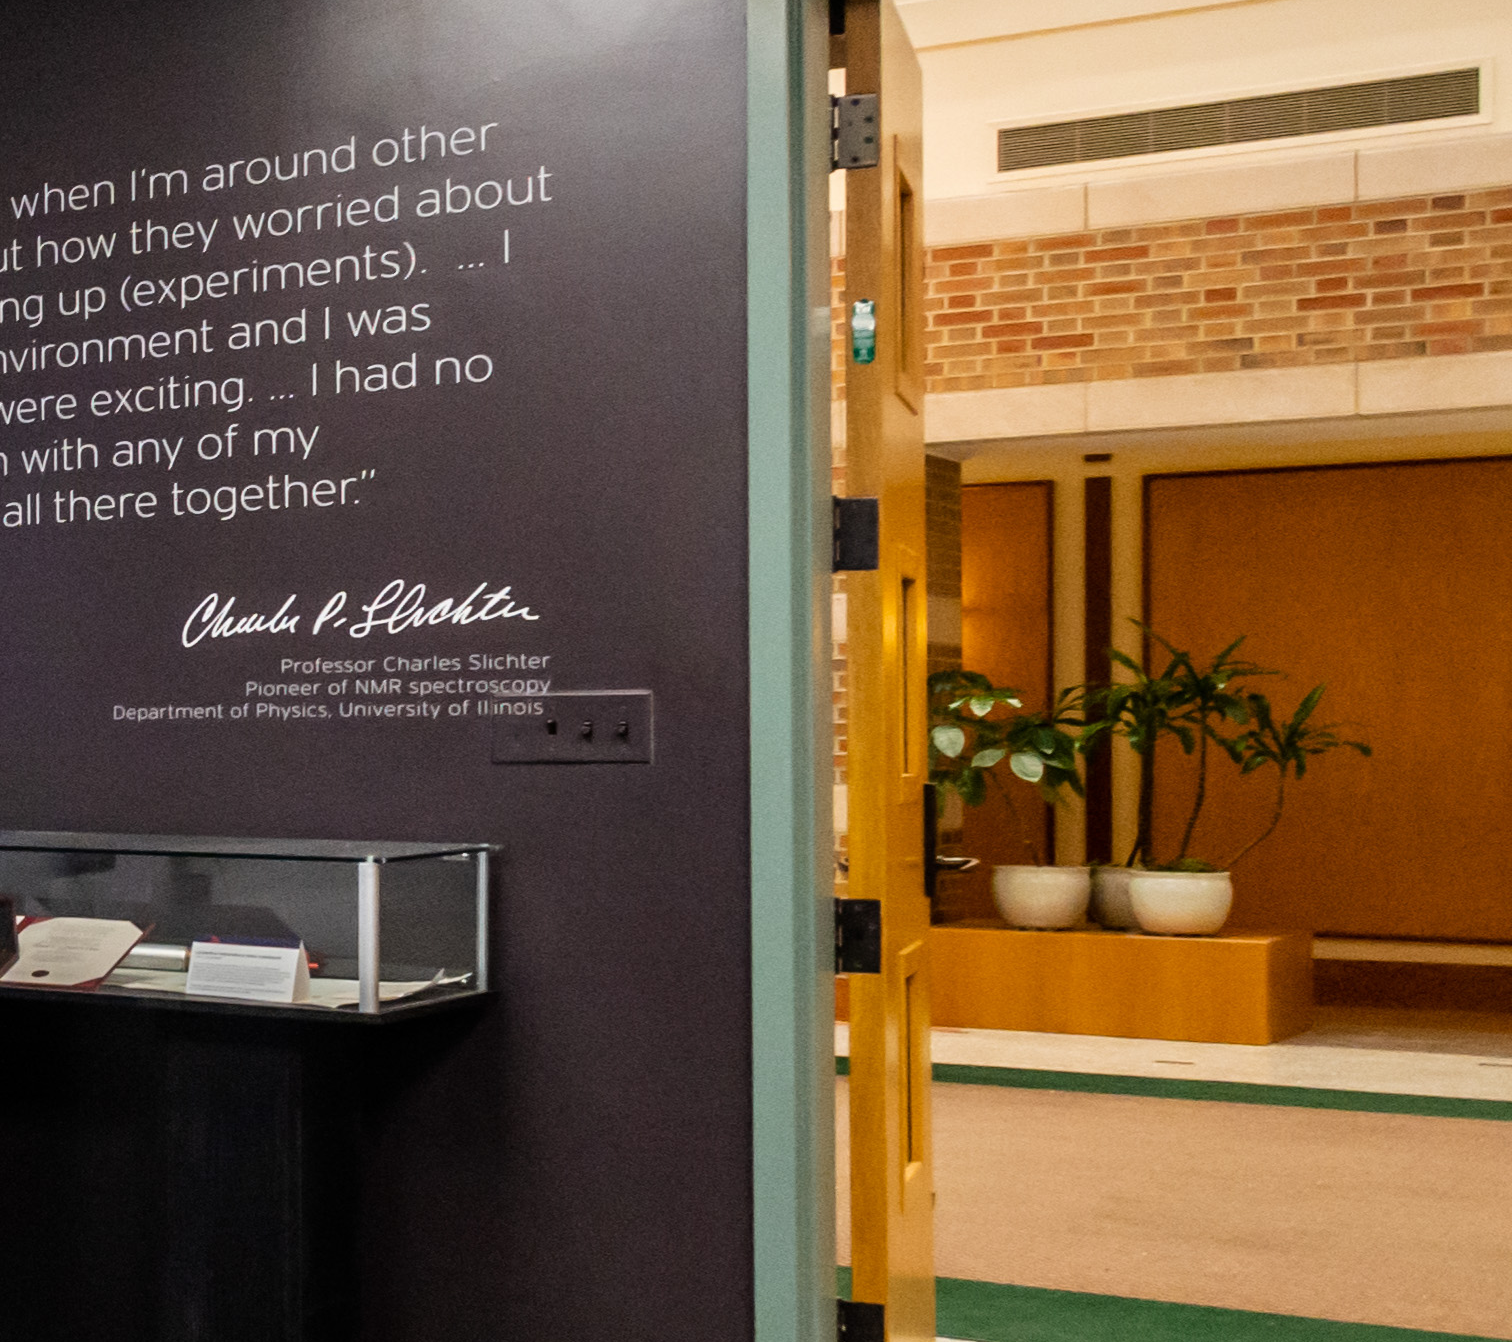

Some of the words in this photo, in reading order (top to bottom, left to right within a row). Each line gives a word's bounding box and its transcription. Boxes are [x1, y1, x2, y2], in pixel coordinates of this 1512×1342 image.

[11, 181, 115, 219] when
[203, 136, 356, 191] around
[373, 122, 498, 166] other
[37, 233, 116, 267] how
[130, 219, 218, 254] they
[233, 185, 399, 240] worried
[416, 166, 552, 217] about
[59, 287, 106, 319] up
[120, 242, 428, 312] (experiments).
[504, 229, 509, 263] I
[228, 308, 306, 349] and
[325, 307, 329, 339] I
[347, 303, 431, 336] was
[90, 376, 253, 416] exciting.
[312, 363, 317, 395] I
[336, 353, 416, 393] had
[436, 354, 493, 384] no
[21, 438, 98, 474] with
[113, 437, 183, 470] any
[198, 423, 238, 460] of
[254, 426, 319, 459] my
[3, 493, 40, 527] all
[54, 490, 157, 523] there
[246, 681, 321, 696] Pioneer
[328, 679, 347, 695] of
[356, 679, 401, 694] NMR
[409, 677, 551, 697] spectroscopy
[281, 658, 375, 674] Professor
[383, 656, 461, 672] Charles
[469, 654, 550, 670] Slichter
[113, 705, 223, 722] Department
[230, 703, 249, 719] of
[256, 703, 331, 720] Physics,
[339, 702, 440, 719] University
[448, 700, 469, 716] of
[477, 700, 543, 717] Illinois
